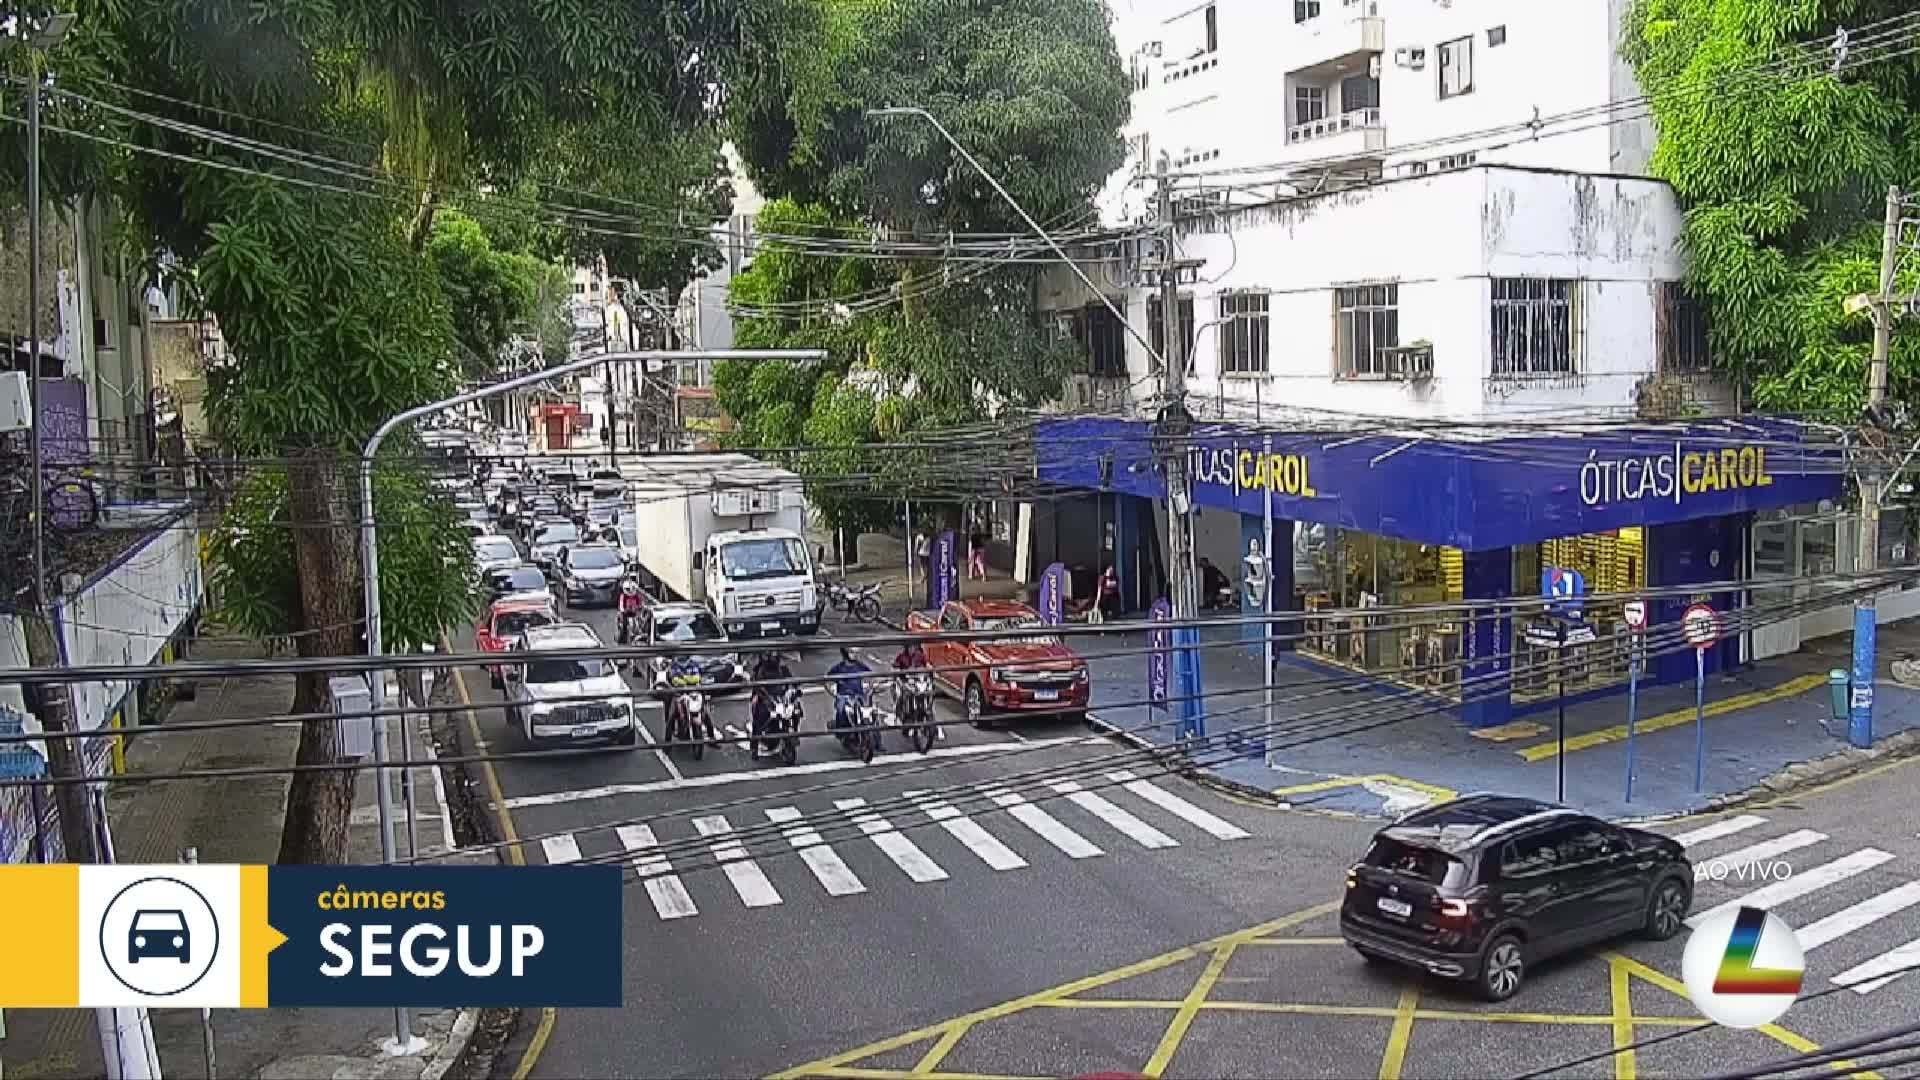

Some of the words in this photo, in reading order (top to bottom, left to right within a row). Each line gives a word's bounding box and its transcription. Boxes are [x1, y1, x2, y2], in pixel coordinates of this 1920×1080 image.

[1187, 447, 1233, 486] TICAS
[1239, 449, 1316, 497] CAROL
[1580, 449, 1674, 505] ÓTICAS
[1682, 447, 1773, 494] CAROL
